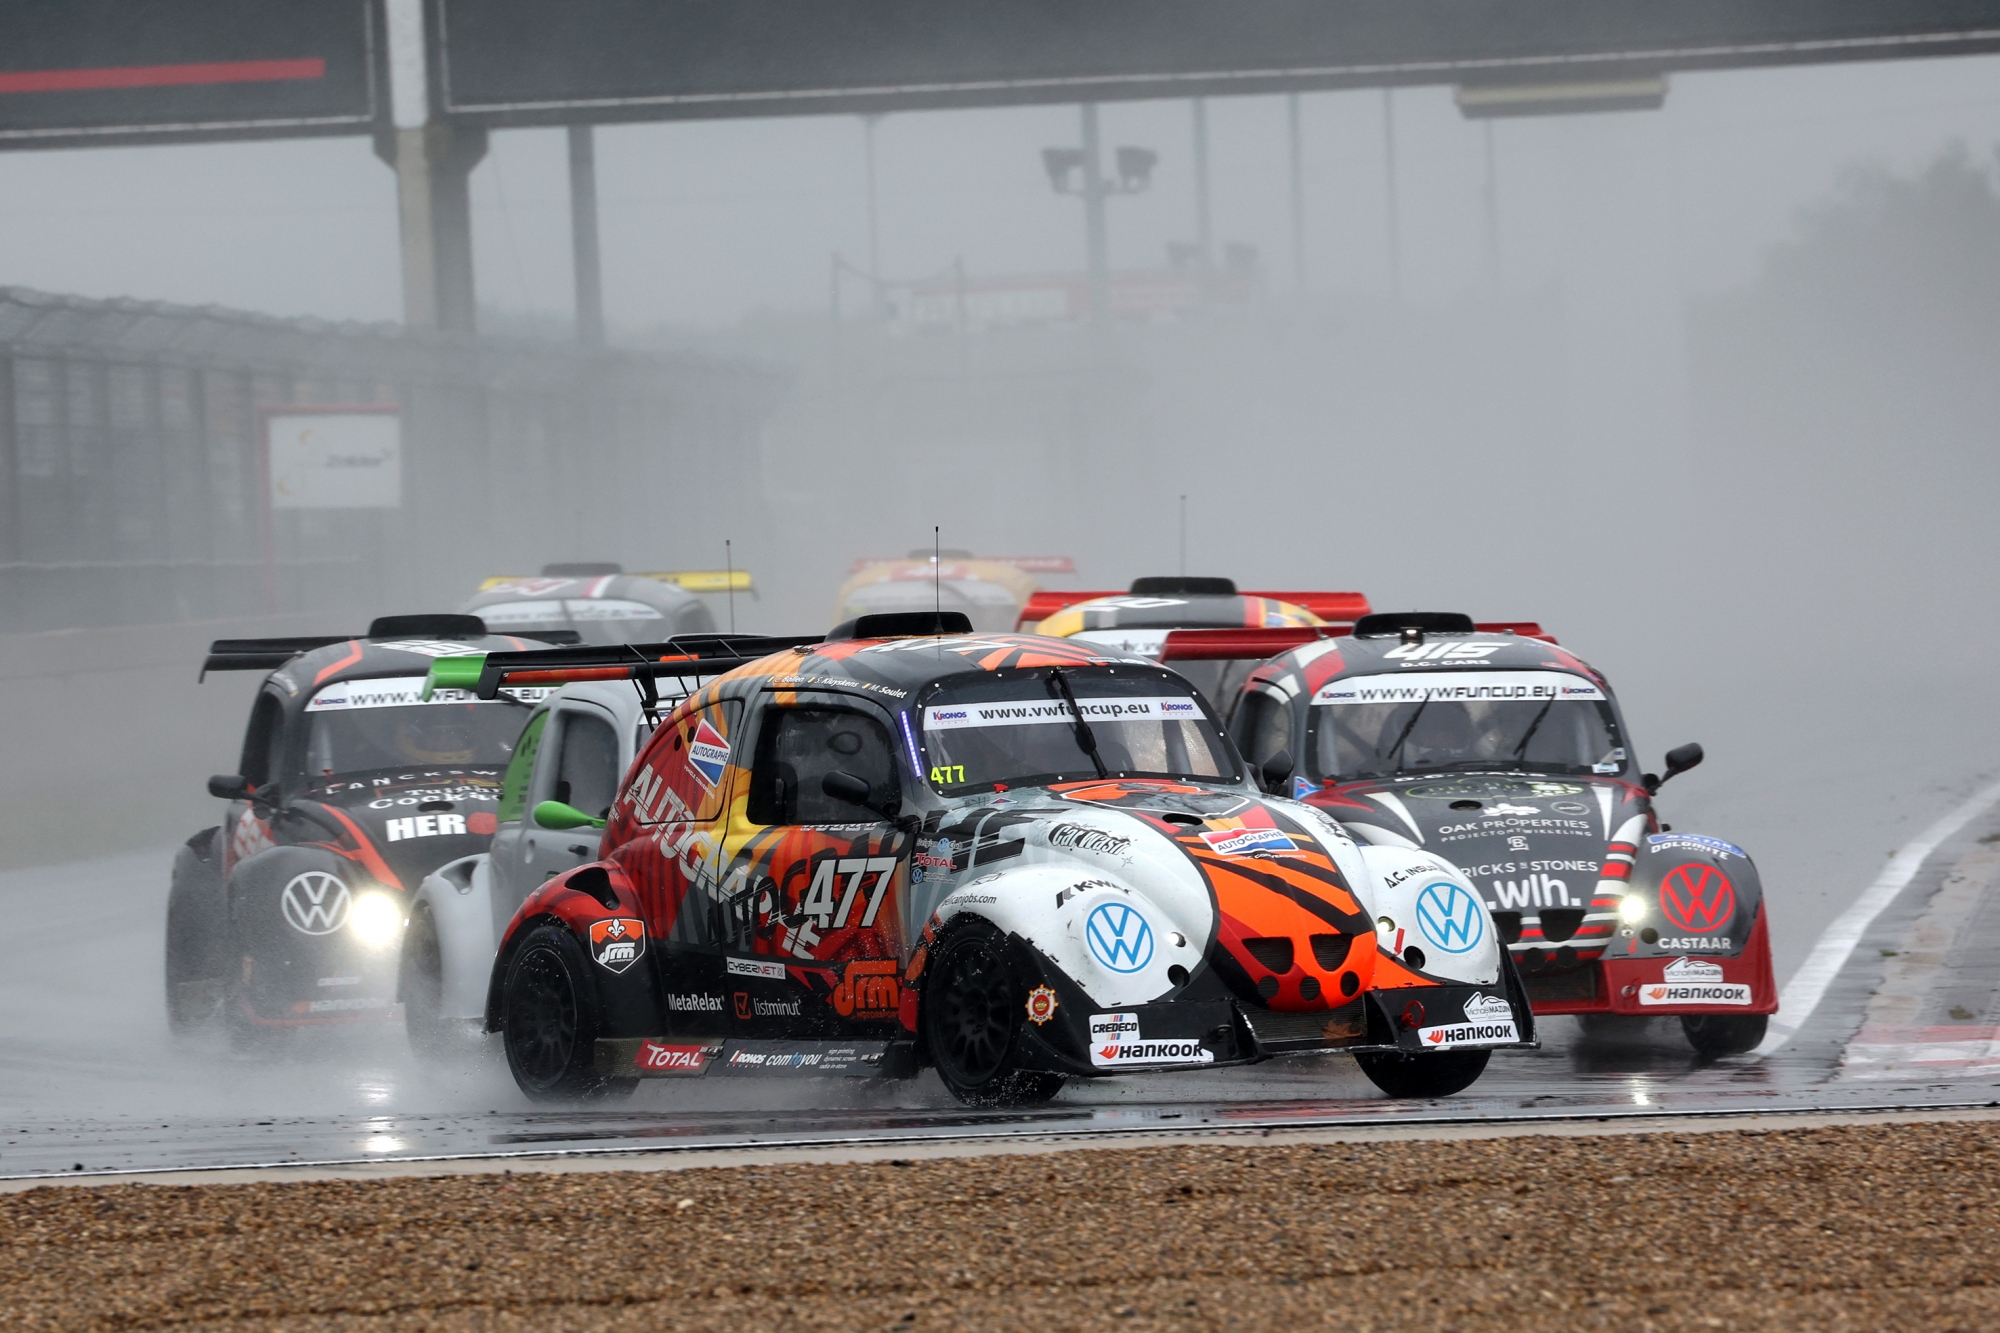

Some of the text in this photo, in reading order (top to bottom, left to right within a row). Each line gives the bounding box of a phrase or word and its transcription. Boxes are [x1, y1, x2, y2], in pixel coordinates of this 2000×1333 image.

[1383, 641, 1513, 661] 415
[878, 686, 908, 699] Soulet
[933, 701, 1194, 721] KRONOS www.vwfuncup.eu KRONOS
[691, 744, 729, 763] AUTOGRAPHE
[930, 765, 966, 785] 477
[1438, 817, 1590, 834] OAK PROPERTIES
[1052, 825, 1131, 855] Car Wash
[1217, 830, 1285, 852] AUTOGRAPHE
[1651, 841, 1730, 860] DOLOMITE
[916, 853, 957, 869] TOTAL
[1461, 862, 1516, 878] RICKS
[1530, 860, 1599, 872] STONES
[803, 857, 898, 929] 477
[1657, 937, 1732, 950] CASTAAR
[728, 961, 777, 975] CYBERNET
[667, 992, 724, 1012] MetaRelax
[1092, 1022, 1138, 1034] CREDECO
[647, 1043, 700, 1067] TOTAL
[729, 1048, 823, 1068] KRONOS comtoyou
